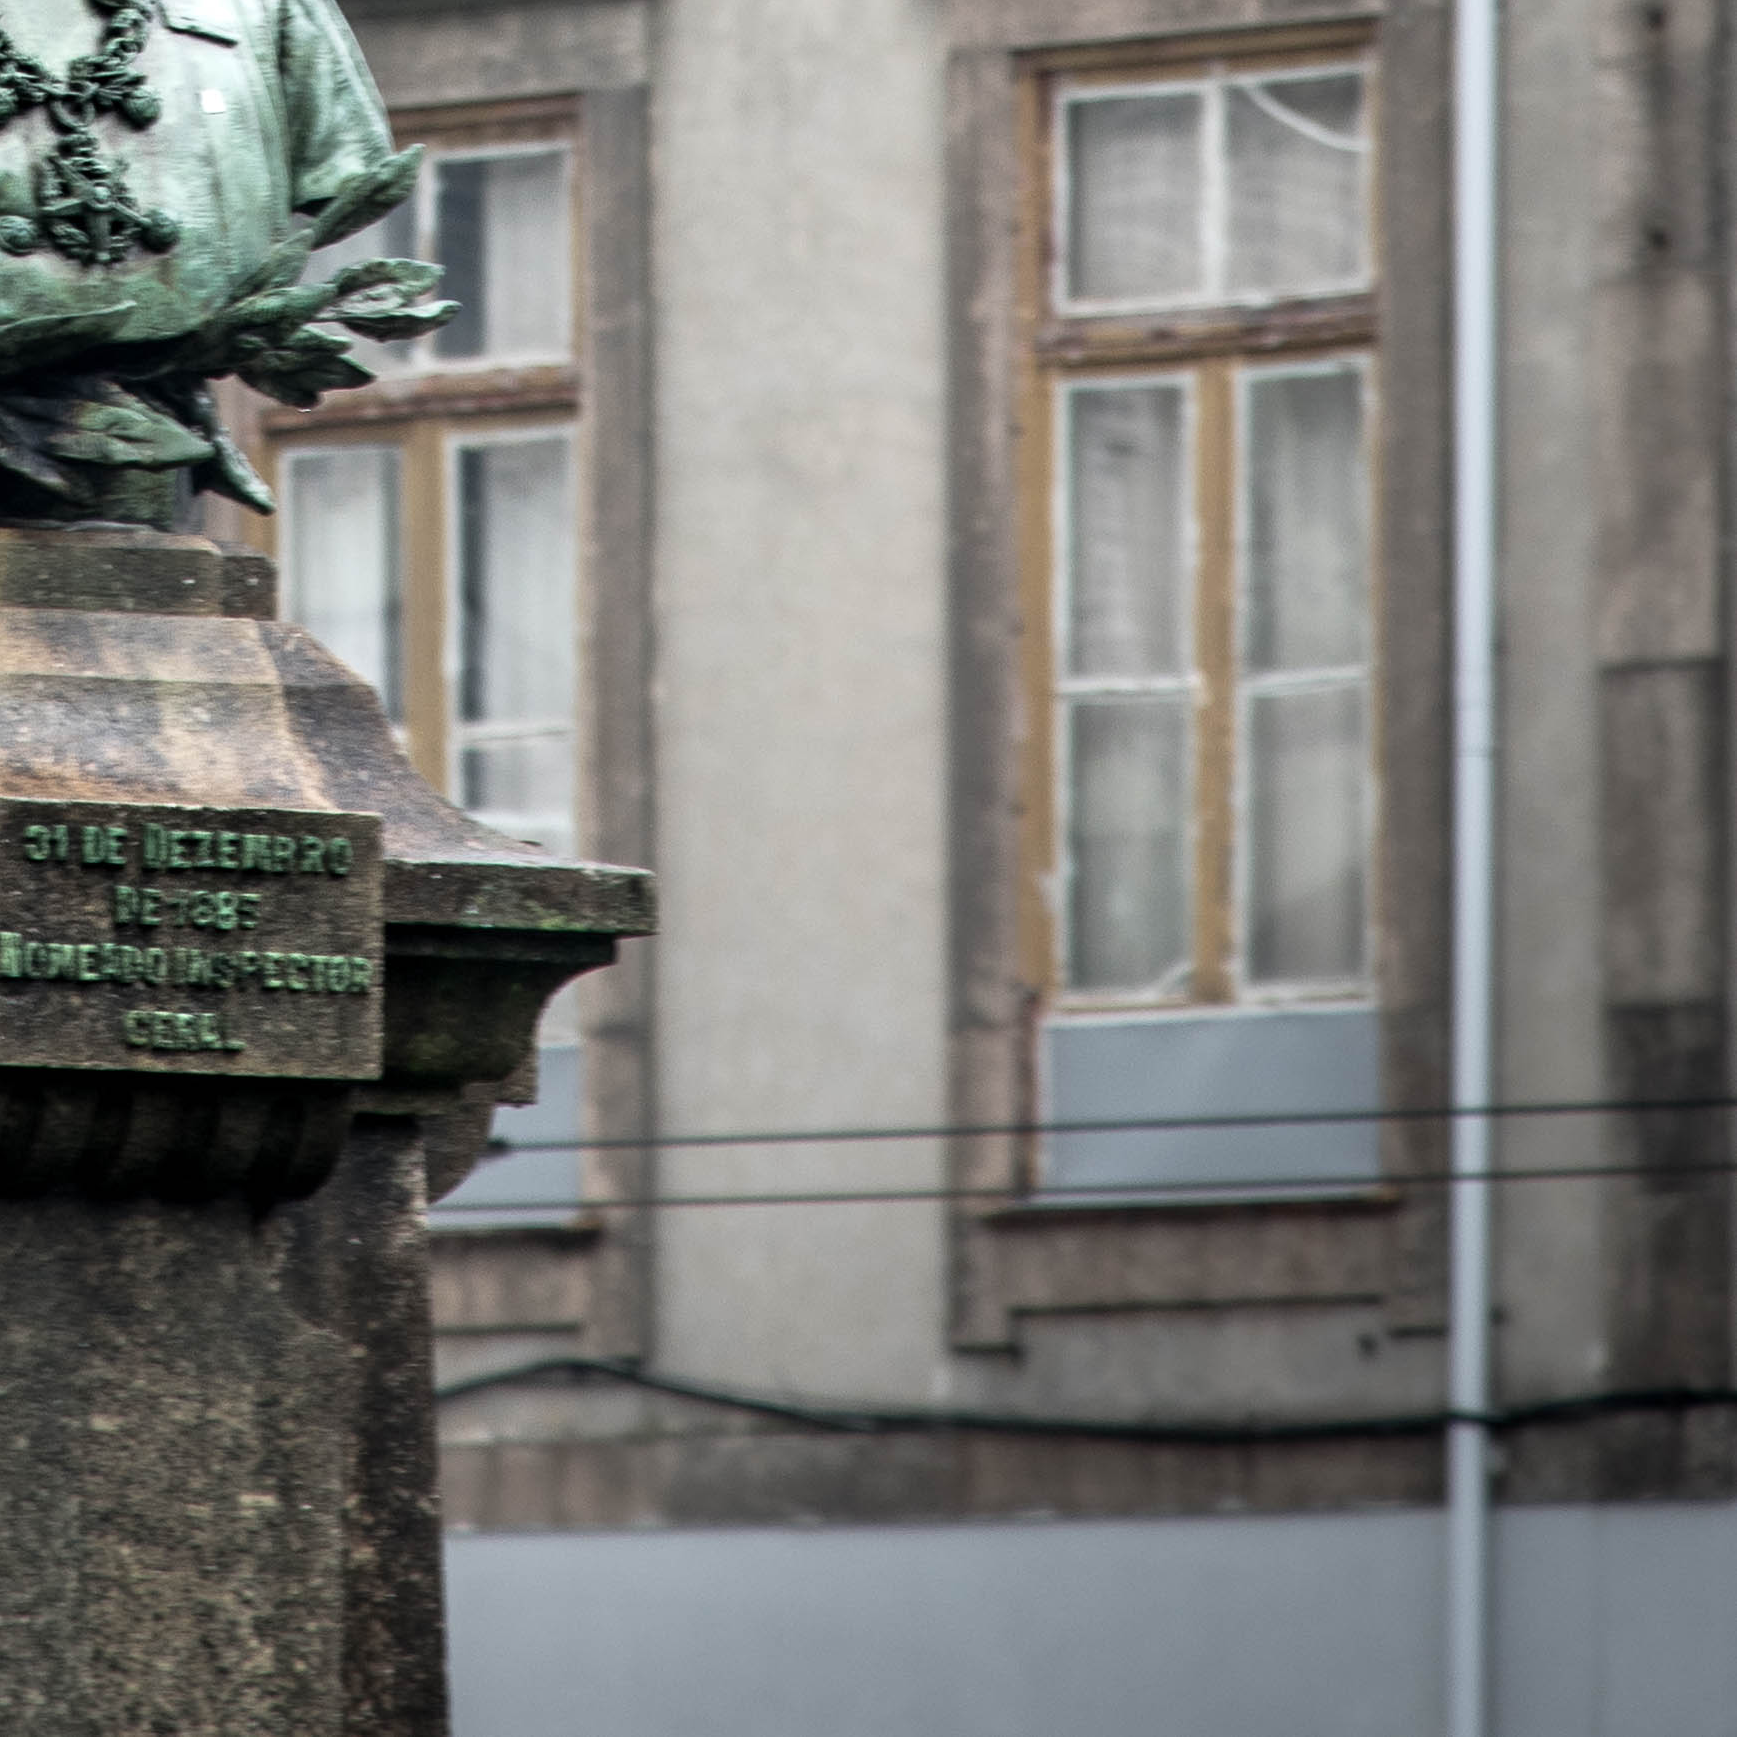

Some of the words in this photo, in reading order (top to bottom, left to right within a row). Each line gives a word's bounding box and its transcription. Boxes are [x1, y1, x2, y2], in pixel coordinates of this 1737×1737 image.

[24, 824, 67, 861] 31
[82, 825, 128, 865] DE
[143, 822, 354, 875] DEZEMBRO
[115, 885, 161, 926] DE
[172, 947, 373, 993] INSPECTOR
